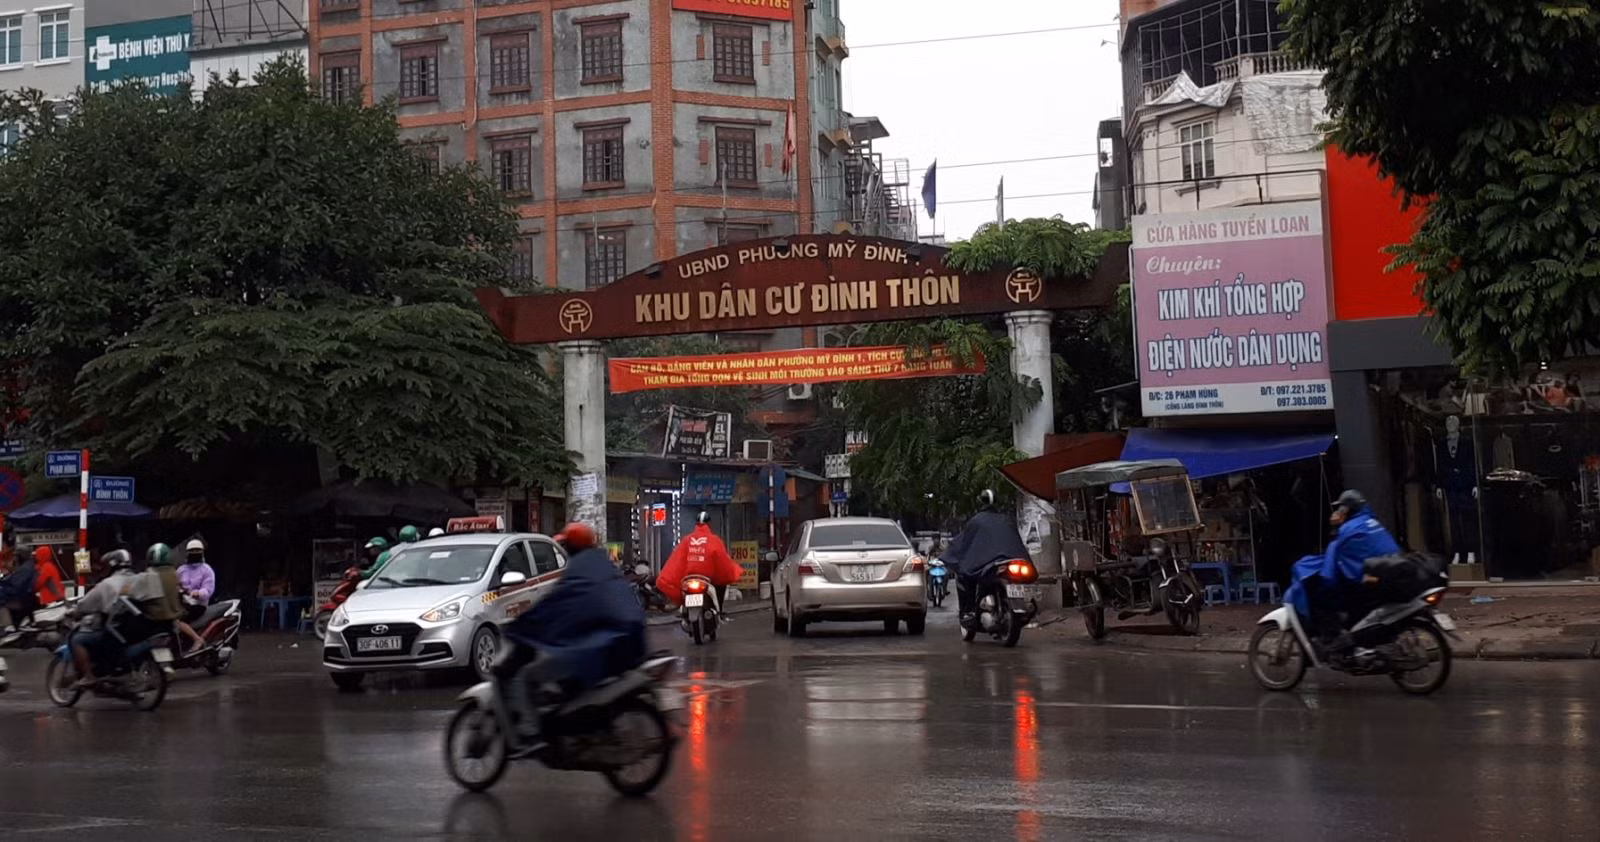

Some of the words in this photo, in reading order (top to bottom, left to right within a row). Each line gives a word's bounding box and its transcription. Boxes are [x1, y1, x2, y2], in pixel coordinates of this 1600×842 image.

[118, 38, 142, 62] BỆNH
[144, 35, 164, 59] VIỆN
[184, 33, 190, 48] Y
[1147, 220, 1175, 243] CỬA
[1179, 221, 1217, 241] HÀNG
[1221, 213, 1267, 238] TUYỂN
[1271, 215, 1309, 234] LOAN
[678, 254, 730, 279] UBND
[828, 239, 856, 259] MỸ
[864, 242, 907, 264] ĐÌNH
[1146, 256, 1222, 275] Chuyên:
[636, 292, 691, 324] KHU
[699, 282, 757, 321] DÂN
[765, 282, 804, 315] CƯ
[811, 275, 877, 313] ĐÌNH
[885, 268, 961, 307] THÔN
[1158, 288, 1190, 321] KIM
[1193, 279, 1221, 318] KHÍ
[1224, 272, 1267, 317] TỔNG
[1271, 278, 1305, 320] HỢP
[693, 361, 714, 371] VIÊN
[730, 358, 755, 369] NHÂN
[757, 357, 776, 368] DÂN
[816, 353, 831, 364] MỸ
[832, 352, 854, 363] ĐÌNH
[1148, 332, 1186, 377] ĐIỆN
[1190, 327, 1234, 369] NƯỚC
[1237, 329, 1271, 367] DÂN
[1276, 332, 1322, 372] DỤNG
[643, 375, 668, 386] THAM
[669, 375, 685, 384] GIA
[746, 371, 768, 381] SINH
[770, 369, 787, 380] MÔI
[827, 365, 845, 377] VÀO
[847, 364, 872, 376] SÁNG
